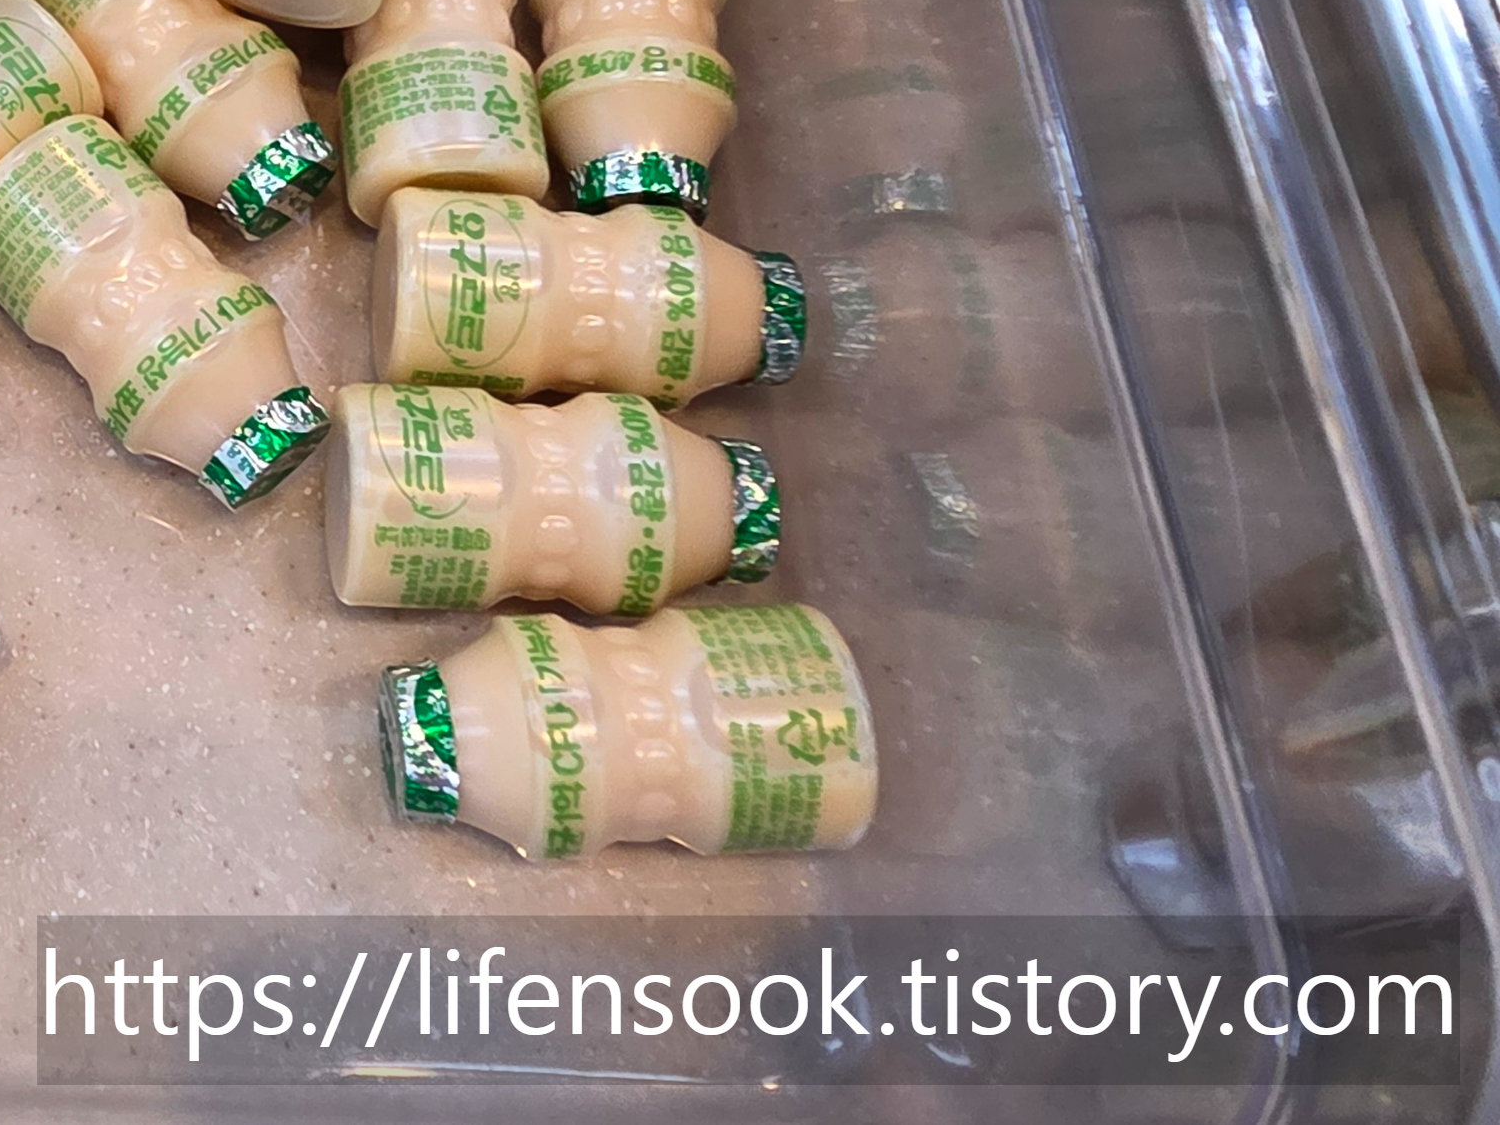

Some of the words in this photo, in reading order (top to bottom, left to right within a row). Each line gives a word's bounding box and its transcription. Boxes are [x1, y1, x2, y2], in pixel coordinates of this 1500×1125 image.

[667, 262, 696, 321] 40%
[619, 407, 658, 454] 40%
[628, 460, 666, 522] 감량
